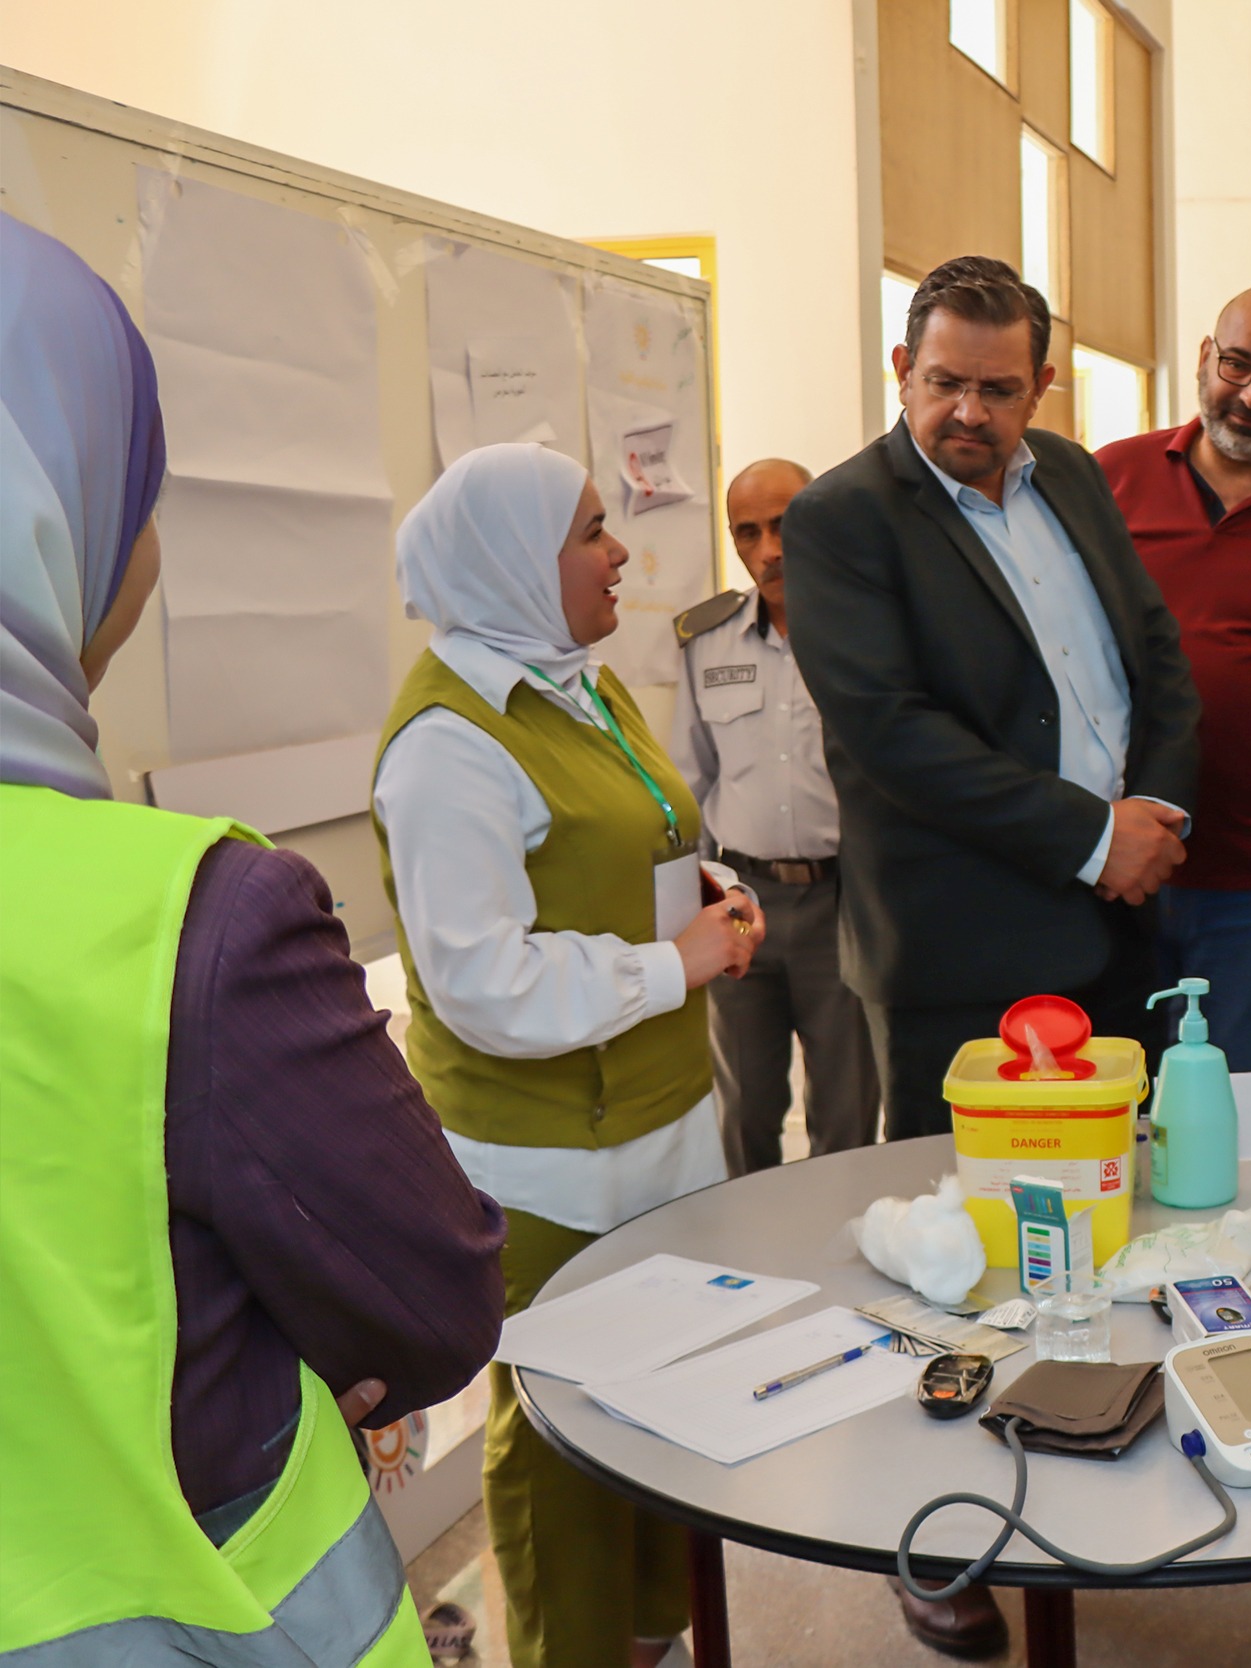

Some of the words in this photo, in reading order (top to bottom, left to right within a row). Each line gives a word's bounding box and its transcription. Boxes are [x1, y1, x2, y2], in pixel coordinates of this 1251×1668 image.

[705, 668, 754, 684] SECURITY
[1011, 1137, 1062, 1149] DANGER
[1212, 1278, 1233, 1287] 50
[1203, 1344, 1236, 1356] OMRON
